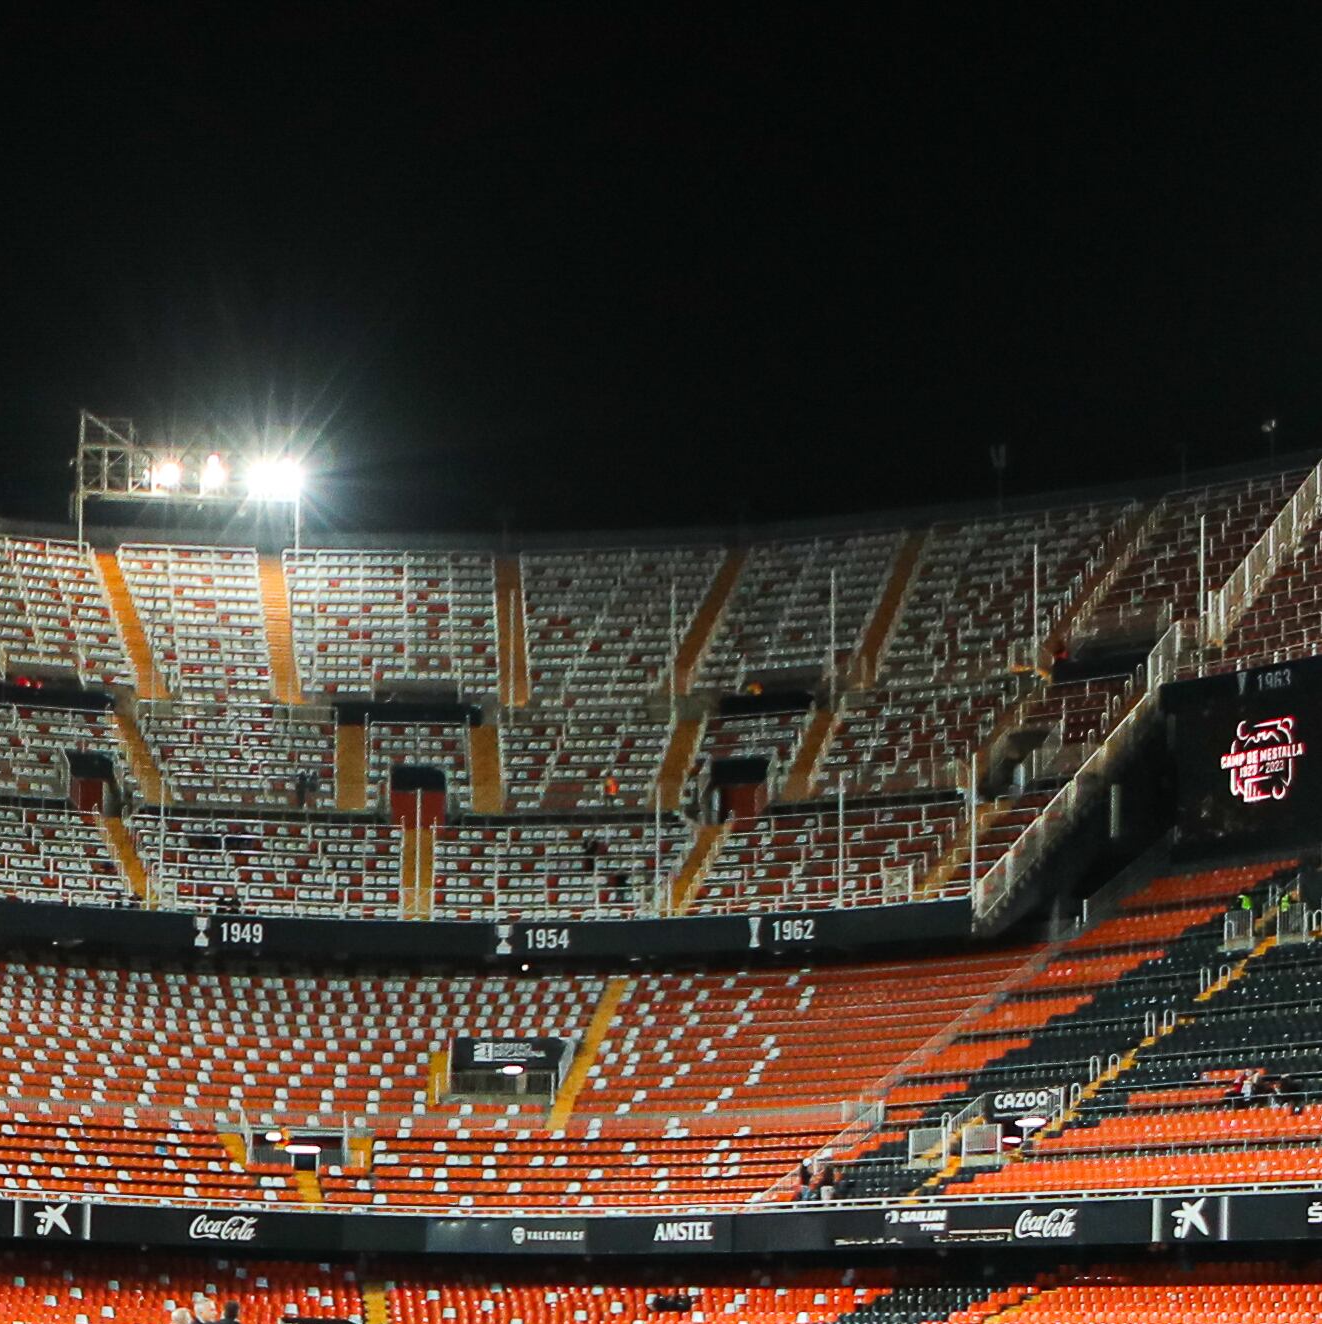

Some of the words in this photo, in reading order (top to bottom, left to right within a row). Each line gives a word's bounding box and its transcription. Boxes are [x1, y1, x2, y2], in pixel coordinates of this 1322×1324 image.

[1257, 669, 1291, 691] 1963
[1220, 752, 1246, 769] CAMP
[1246, 750, 1258, 764] DE
[1260, 743, 1303, 762] MESTALLA
[1265, 760, 1284, 774] 2023
[220, 922, 264, 944] 1949
[524, 929, 570, 950] 1954
[772, 919, 815, 941] 1962
[994, 1091, 1048, 1110] CAZOO
[899, 1209, 948, 1223] SAILUN
[653, 1221, 714, 1242] AMSTEL
